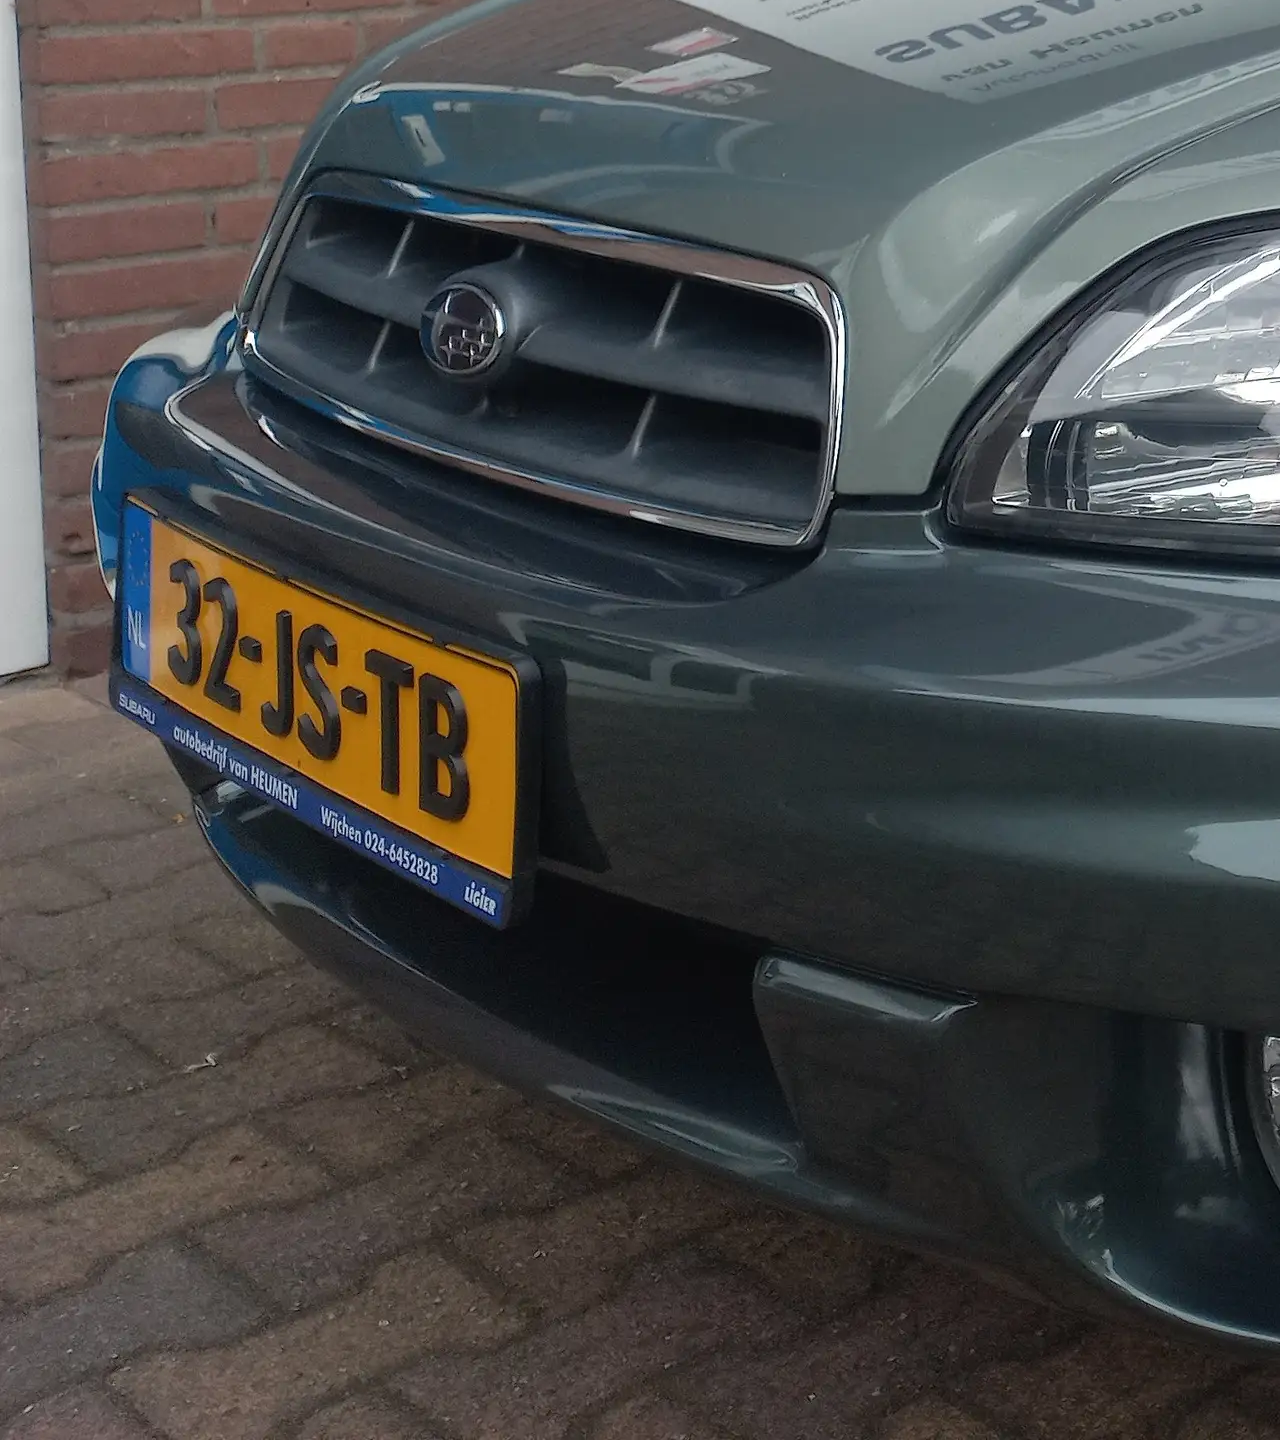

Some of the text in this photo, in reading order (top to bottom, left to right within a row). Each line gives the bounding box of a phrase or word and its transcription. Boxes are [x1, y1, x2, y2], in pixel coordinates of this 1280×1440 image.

[126, 605, 147, 651] NL
[118, 693, 156, 726] SUBARU
[167, 558, 471, 823] 32-JS-TB
[173, 724, 298, 811] autobedrijf van HEUMEN
[319, 804, 362, 844] Wijchen
